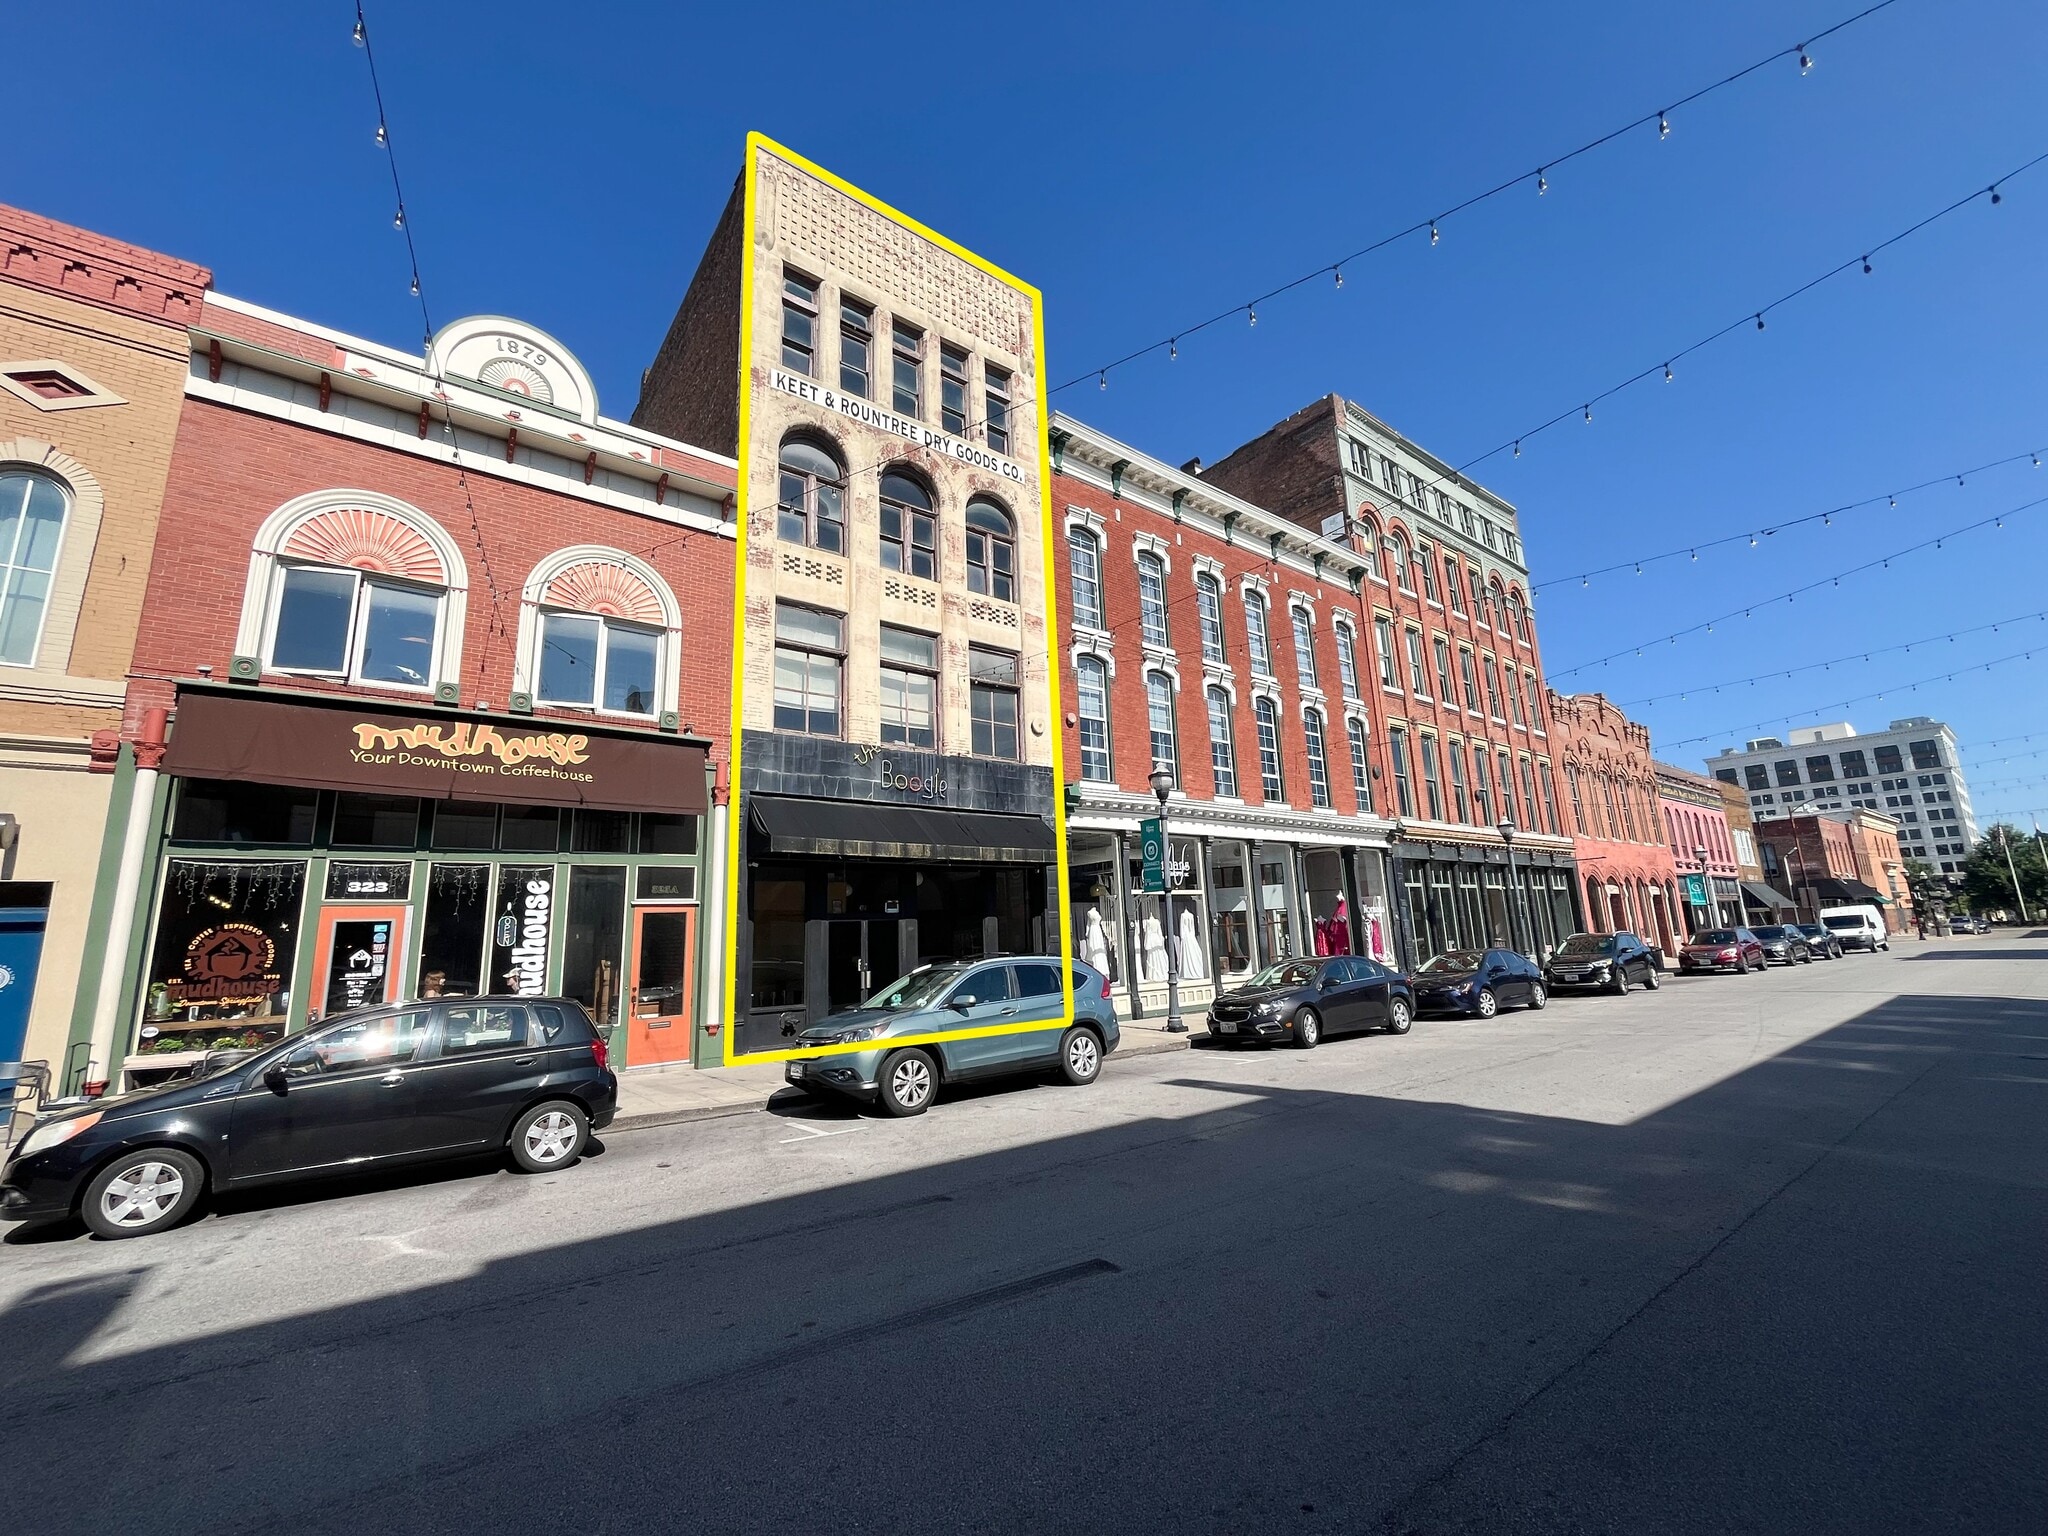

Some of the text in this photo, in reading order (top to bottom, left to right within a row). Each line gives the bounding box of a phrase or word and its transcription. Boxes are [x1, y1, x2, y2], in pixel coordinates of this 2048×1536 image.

[496, 338, 547, 366] 1879
[776, 372, 1023, 481] KEET & ROUNTREE DRY GOODS CO.
[352, 722, 591, 765] mudhouse
[854, 744, 881, 764] the
[350, 749, 593, 783] Your Downtown Coffeehouse
[347, 881, 389, 893] 323
[188, 928, 214, 950] COFFEE
[223, 923, 263, 936] ESPRESSO
[264, 939, 275, 968] GOODIES
[502, 917, 512, 946] OPEN
[167, 977, 280, 1001] mudhouse
[219, 995, 266, 1007] Springfield
